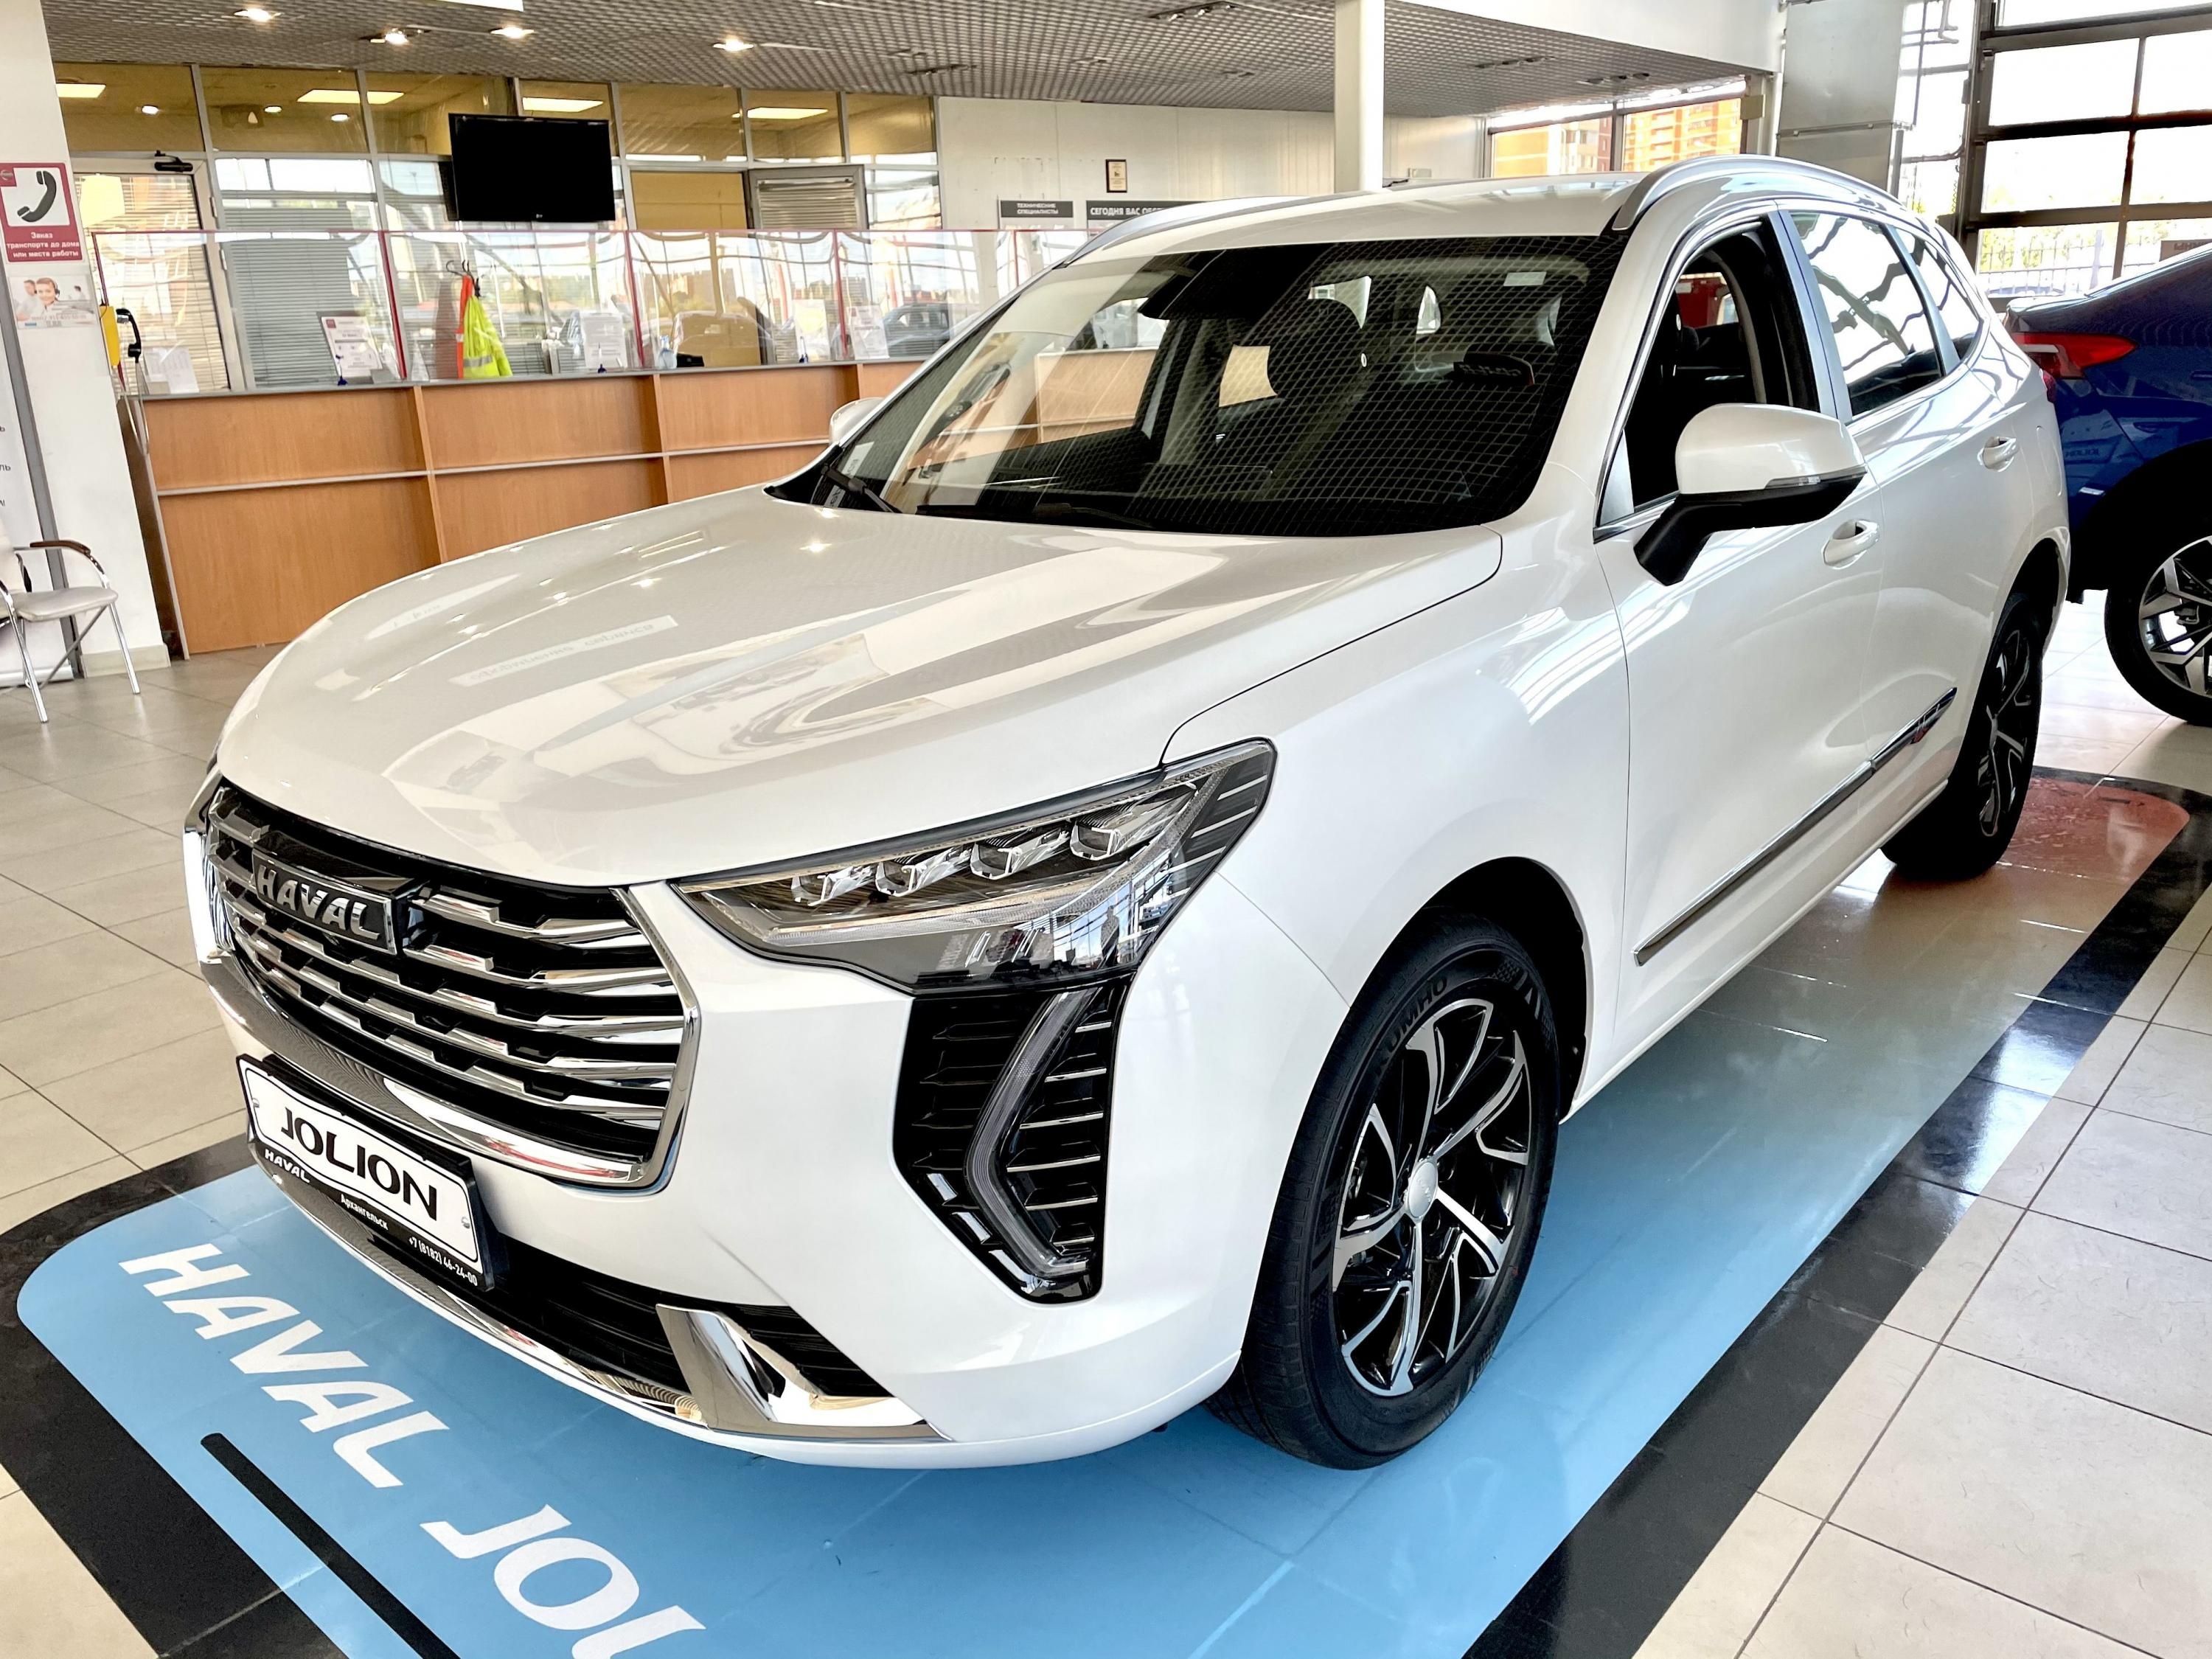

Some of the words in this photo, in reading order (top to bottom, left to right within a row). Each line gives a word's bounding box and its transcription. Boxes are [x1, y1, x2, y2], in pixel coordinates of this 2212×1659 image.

[1091, 207, 1124, 216] СЕГОДНЯ
[6, 241, 49, 250] транспорта
[52, 249, 79, 258] работы
[257, 864, 380, 940] HAVAL
[265, 1149, 311, 1183] HAVAL
[281, 1107, 438, 1222] JOLION
[341, 1193, 389, 1231] Архангельск
[408, 1237, 418, 1248] +7
[418, 1239, 442, 1265] (8182)
[443, 1256, 478, 1287] 46-24-00
[119, 1243, 449, 1488] HAVAL
